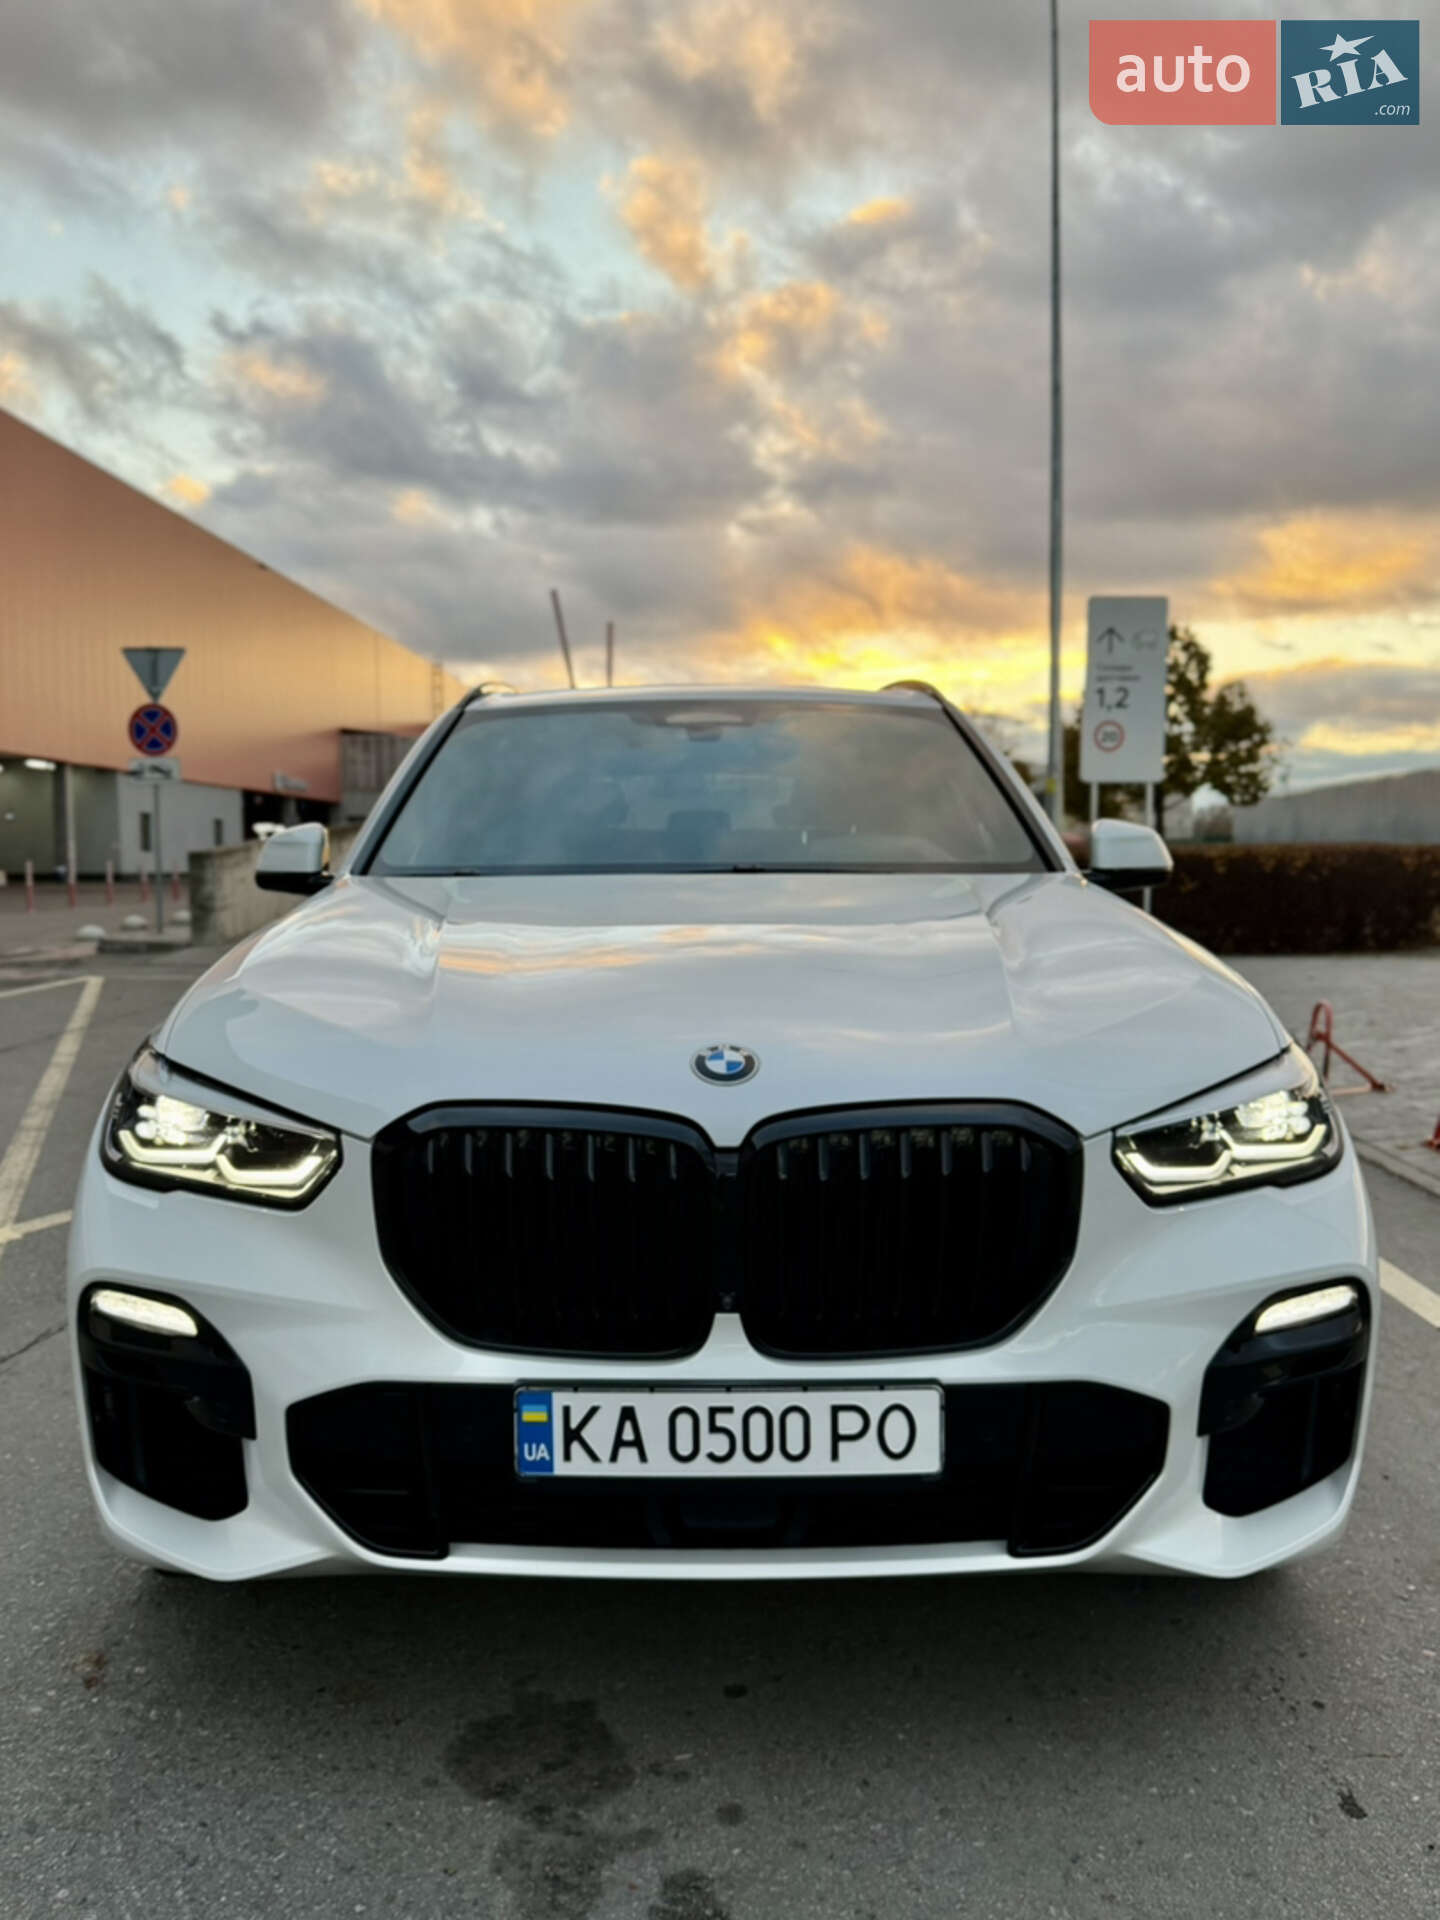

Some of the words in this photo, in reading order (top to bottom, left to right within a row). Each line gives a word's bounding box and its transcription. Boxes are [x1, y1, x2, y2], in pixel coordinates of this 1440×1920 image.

[524, 1443, 550, 1461] UA
[562, 1405, 649, 1464] KA
[668, 1405, 811, 1464] 0500
[830, 1403, 917, 1463] PO
